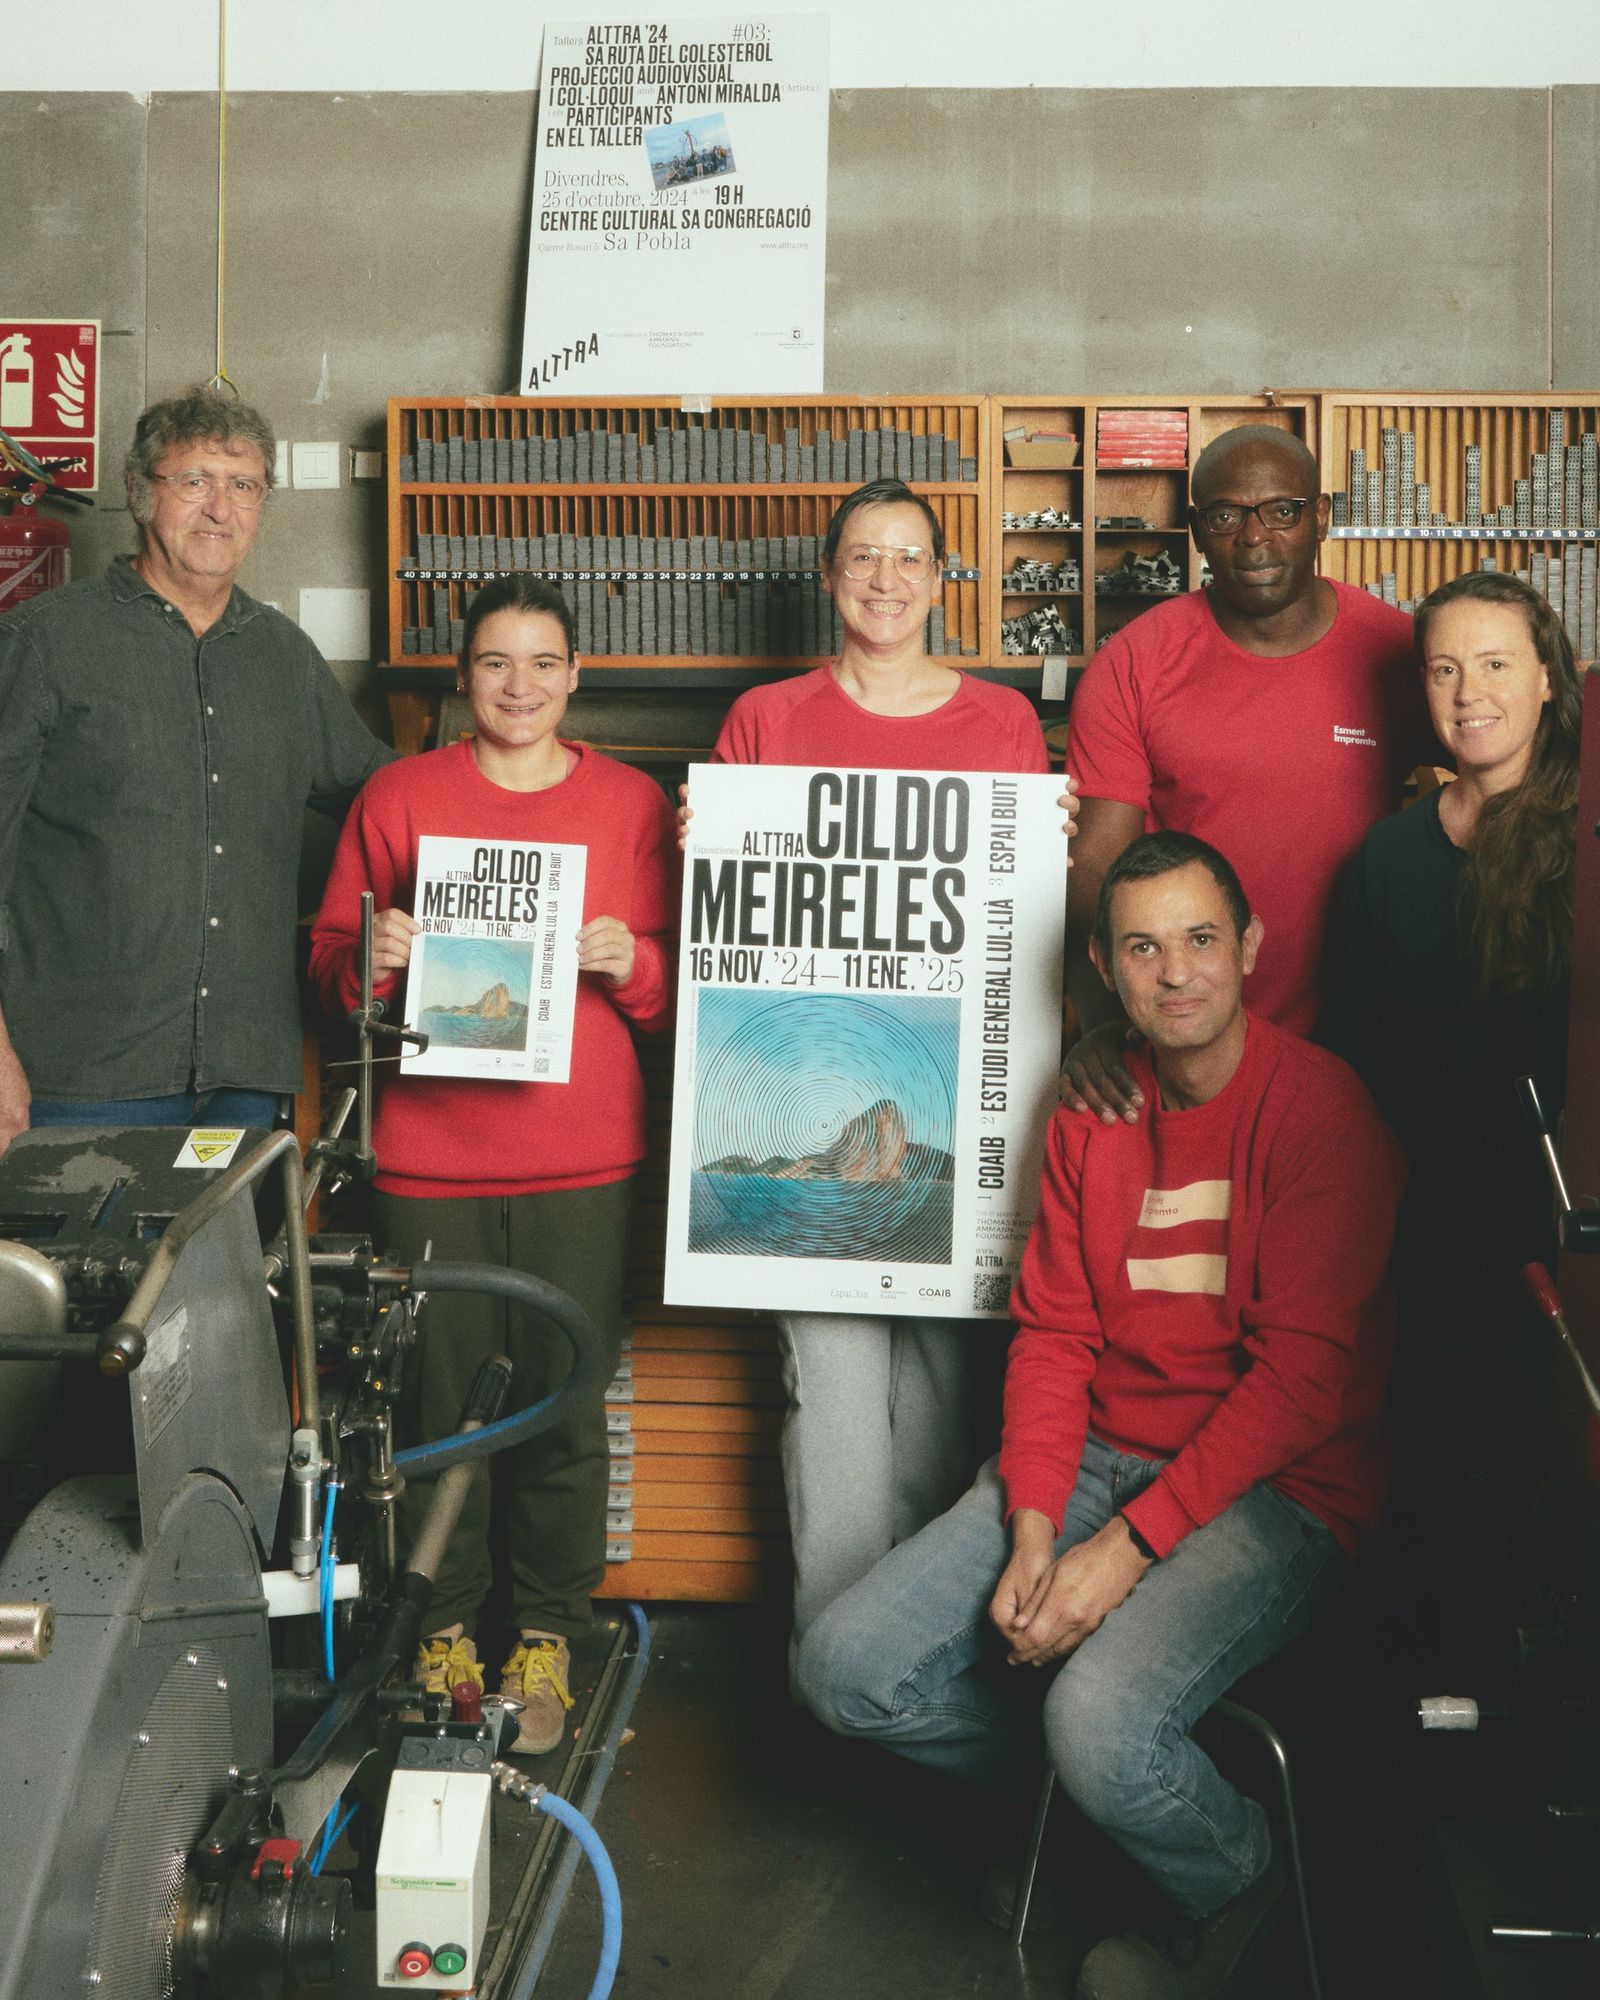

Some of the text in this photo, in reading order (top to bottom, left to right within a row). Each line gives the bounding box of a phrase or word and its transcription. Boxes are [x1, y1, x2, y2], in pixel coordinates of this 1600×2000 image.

[553, 24, 668, 46] Tallers ALTTRA '24
[732, 23, 771, 42] #03:
[585, 42, 773, 65] SA RUTA DEL COLESTEROL
[550, 62, 735, 86] PROJECCIÓ AUDIOVISUAL
[549, 87, 554, 106] I
[557, 85, 634, 108] COL·LOQUI
[657, 84, 711, 104] ANTONI
[715, 83, 781, 104] MIRALDA
[566, 106, 673, 126] PARTICIPANTS
[546, 127, 643, 147] EN EL TALLER
[544, 169, 629, 188] Divendres,
[541, 191, 561, 208] 25
[565, 190, 645, 209] d'octubre,
[650, 188, 688, 207] 2024
[715, 185, 730, 205] 19
[734, 185, 743, 205] H
[540, 205, 811, 231] CENTRE CULTURAL SA CONGREGACIÓ
[604, 231, 691, 251] Sa Pobla
[1371, 529, 1378, 537] 7
[1387, 529, 1394, 537] 8
[1404, 529, 1411, 537] 9
[1420, 529, 1429, 537] 10
[1437, 529, 1446, 537] 11
[1452, 529, 1462, 537] 12
[1470, 529, 1479, 538] 13
[1485, 529, 1495, 538] 14
[1502, 529, 1511, 538] 15
[1518, 529, 1527, 538] 16
[1535, 529, 1544, 538] 17
[1552, 529, 1561, 538] 18
[1568, 529, 1577, 538] 19
[1584, 529, 1596, 538] 20
[404, 571, 415, 579] 40
[420, 571, 431, 579] 39
[436, 571, 447, 579] 38
[451, 571, 462, 579] 37
[467, 571, 478, 579] 36
[484, 571, 495, 579] 35
[548, 572, 557, 580] 31
[563, 572, 574, 580] 30
[579, 572, 590, 580] 29
[595, 572, 606, 580] 28
[611, 572, 621, 580] 27
[626, 572, 637, 580] 26
[643, 572, 654, 580] 25
[660, 572, 670, 580] 24
[675, 572, 686, 580] 23
[690, 572, 701, 580] 22
[706, 572, 716, 580] 21
[723, 572, 734, 580] 20
[740, 572, 749, 580] 19
[755, 572, 764, 580] 18
[771, 572, 780, 580] 17
[788, 572, 796, 580] 16
[804, 572, 813, 580] 15
[951, 570, 958, 579] 6
[967, 570, 974, 579] 5
[1333, 725, 1365, 736] Esment
[991, 779, 1018, 819] BUIT
[806, 772, 970, 864] CILDO
[550, 852, 562, 866] BUIT
[990, 824, 1016, 873] ESPAI
[473, 848, 542, 886] CILDO
[549, 866, 560, 891] ESPAI
[422, 881, 539, 923] MEIRELES
[690, 858, 966, 954] MEIRELES
[422, 918, 431, 932] 16
[543, 929, 555, 961] GENERAL
[541, 963, 552, 989] ESTUDI
[690, 948, 713, 981] 16
[719, 949, 769, 984] NOV.
[868, 955, 914, 990] ENE.
[920, 958, 964, 993] '25
[538, 999, 551, 1022] COAIB
[982, 967, 1011, 1044] GENERAL
[981, 1049, 1008, 1112] ESTUDI
[978, 1136, 1005, 1189] COAIB
[975, 1256, 1003, 1267] ALTTRA
[919, 1288, 951, 1297] COAIB
